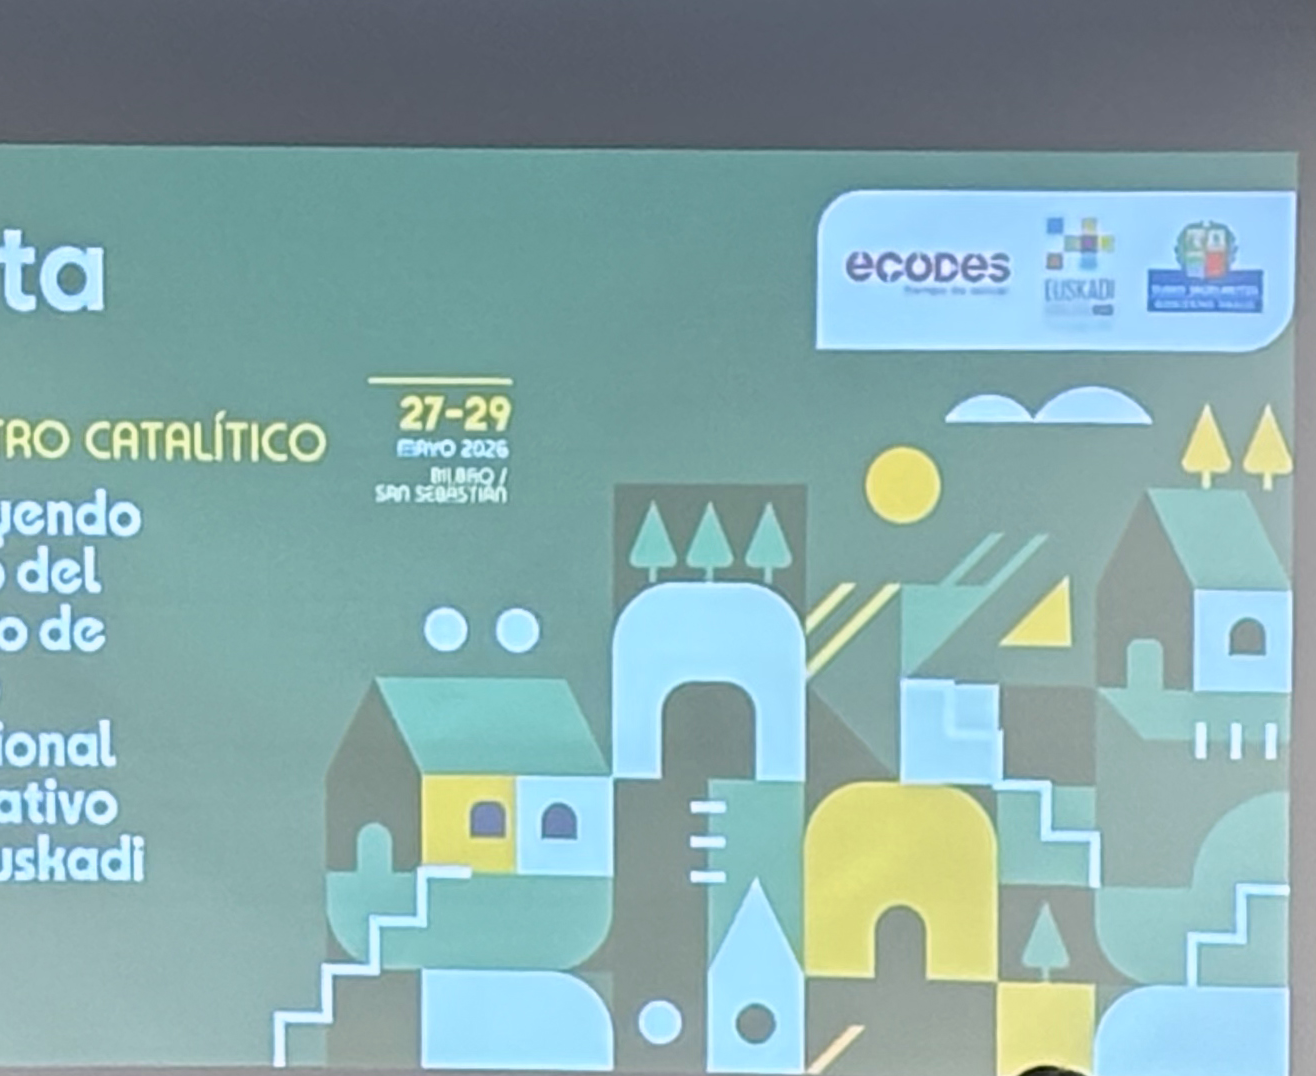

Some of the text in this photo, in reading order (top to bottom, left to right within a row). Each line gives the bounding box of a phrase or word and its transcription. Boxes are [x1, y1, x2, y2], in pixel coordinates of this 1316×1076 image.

[85, 410, 327, 463] CATALÍTICO
[399, 395, 511, 431] 27-29
[460, 438, 510, 459] 2026
[17, 545, 102, 593] del
[39, 603, 106, 652] de
